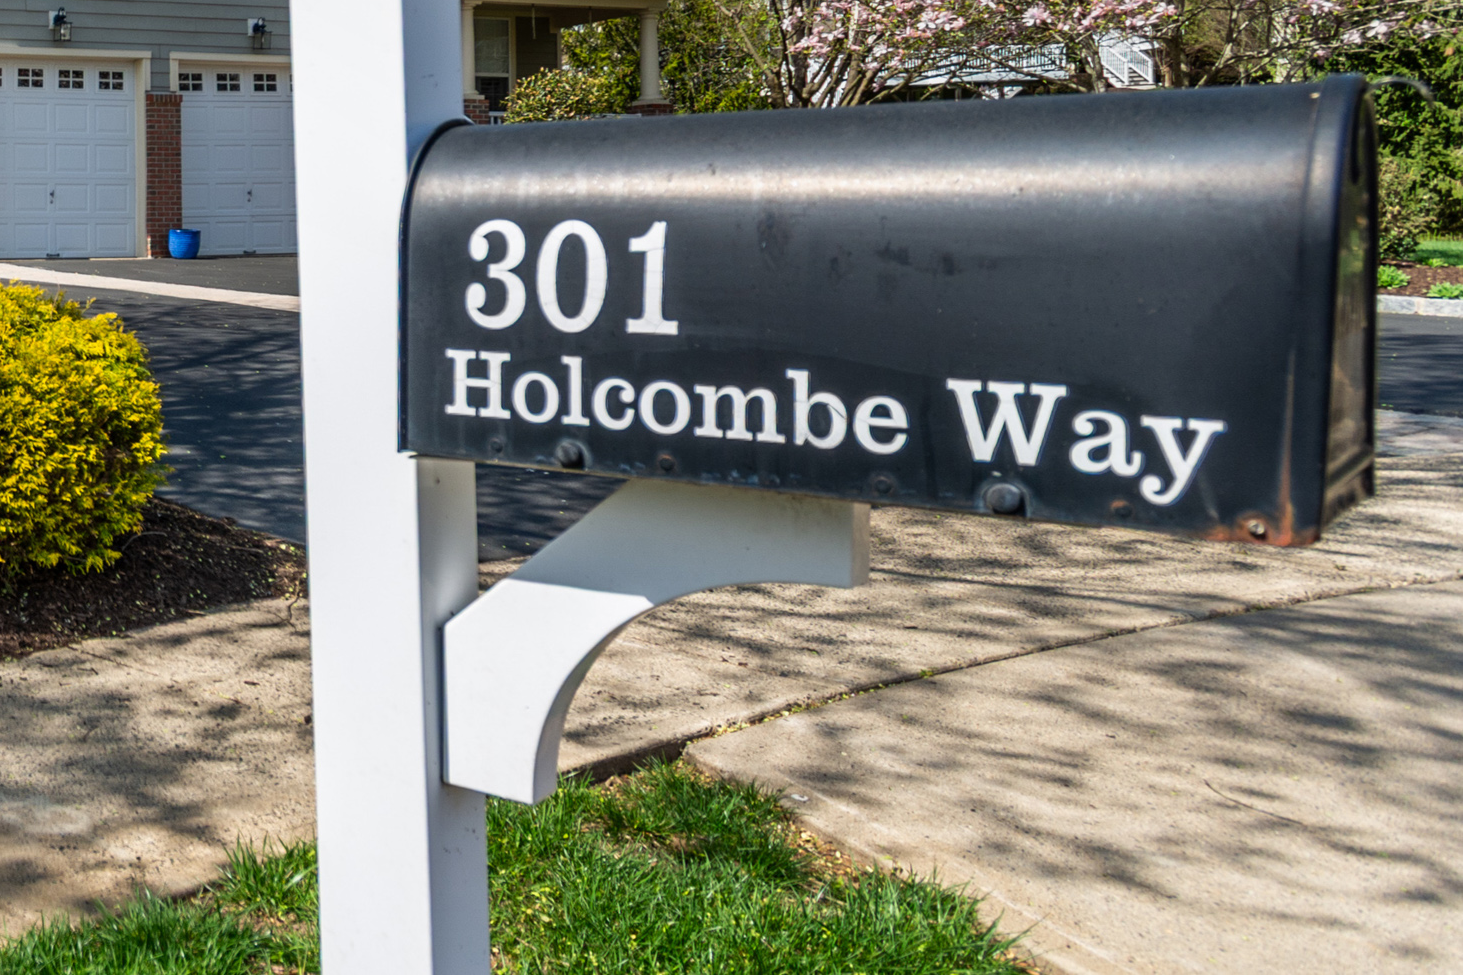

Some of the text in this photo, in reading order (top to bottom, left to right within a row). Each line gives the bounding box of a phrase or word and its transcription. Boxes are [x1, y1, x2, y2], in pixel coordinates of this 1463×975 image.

[464, 219, 680, 336] 301
[443, 348, 1226, 506] Holcombe Way
